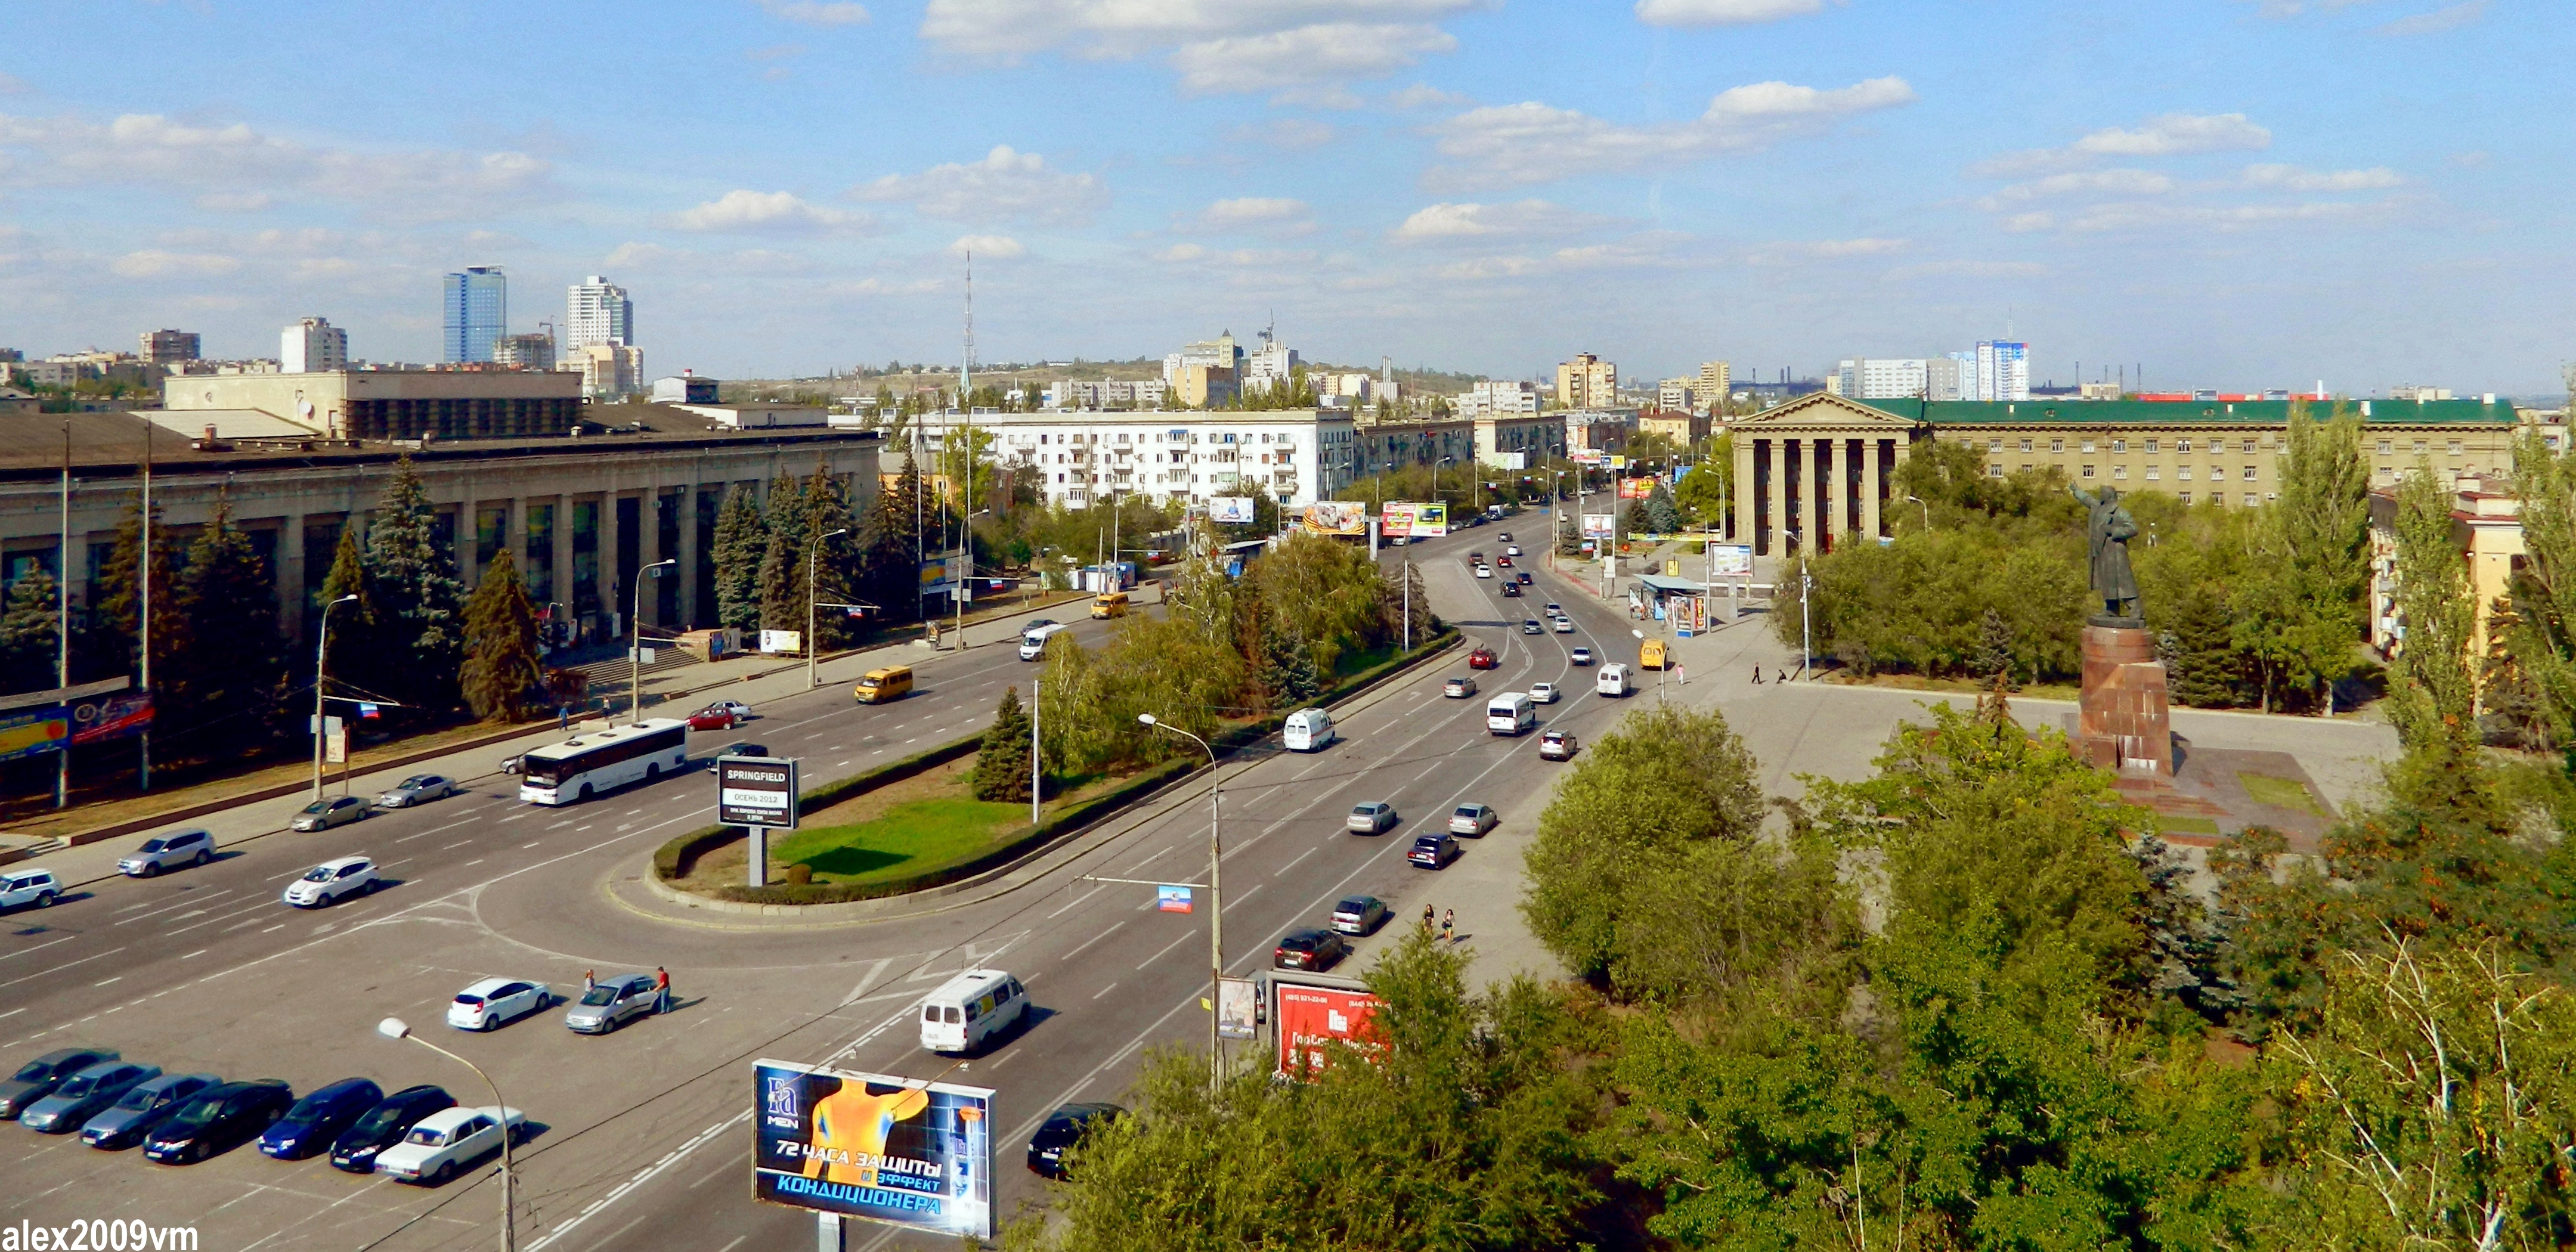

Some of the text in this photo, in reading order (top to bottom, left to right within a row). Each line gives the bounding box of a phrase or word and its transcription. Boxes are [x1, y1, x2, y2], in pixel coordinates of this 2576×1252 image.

[727, 770, 785, 782] SPRINGFIELD
[735, 794, 758, 802] ОСЕНЬ
[767, 1077, 798, 1117] Fa
[767, 1115, 799, 1129] MEN
[776, 1139, 942, 1177] 72 ЧАСА ЗАЩИТЫ
[877, 1173, 940, 1192] ЭФФЕКТ
[777, 1174, 942, 1214] КОНДИЦИОНЕРА
